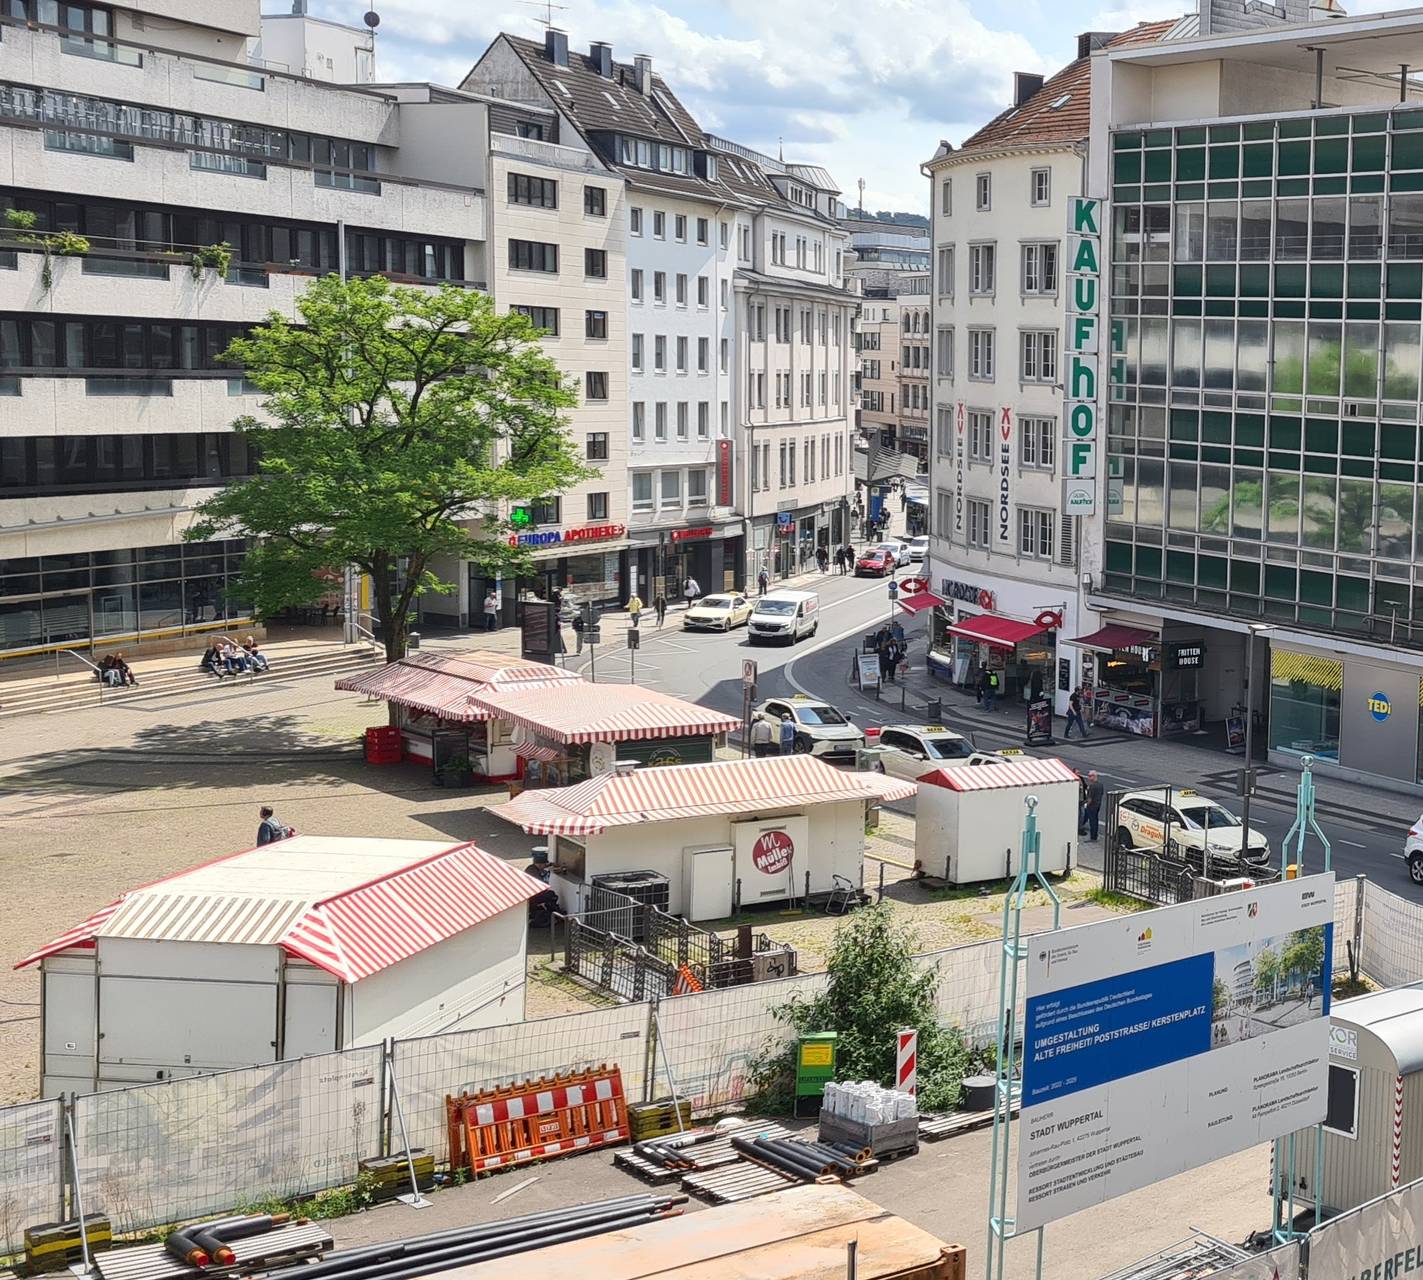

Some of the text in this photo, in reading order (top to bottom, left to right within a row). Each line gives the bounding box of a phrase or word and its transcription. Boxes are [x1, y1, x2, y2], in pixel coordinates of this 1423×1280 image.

[1000, 443, 1010, 540] NORDSEE
[518, 524, 620, 545] EUROPA APOTHEKE
[1178, 648, 1200, 657] FRITTEN
[1179, 657, 1199, 666] HOUSE
[1368, 698, 1391, 715] TEDi
[1033, 1005, 1205, 1062] ALTE FREIHEIT/ POSTSTRASSE/ KERSTENPLATZ
[1034, 1023, 1099, 1049] UMGESTALTUNG
[1029, 1109, 1103, 1141] STADT WUPPERTAL
[1085, 1150, 1096, 1159] DER
[1096, 1144, 1112, 1155] STADT
[1112, 1134, 1141, 1149] WUPPERTAL
[1028, 1181, 1052, 1195] RESSORT
[1104, 1159, 1115, 1168] UND
[1028, 1189, 1052, 1203] RESSORT
[1076, 1177, 1087, 1186] UND
[1087, 1168, 1111, 1182] VERKEHR
